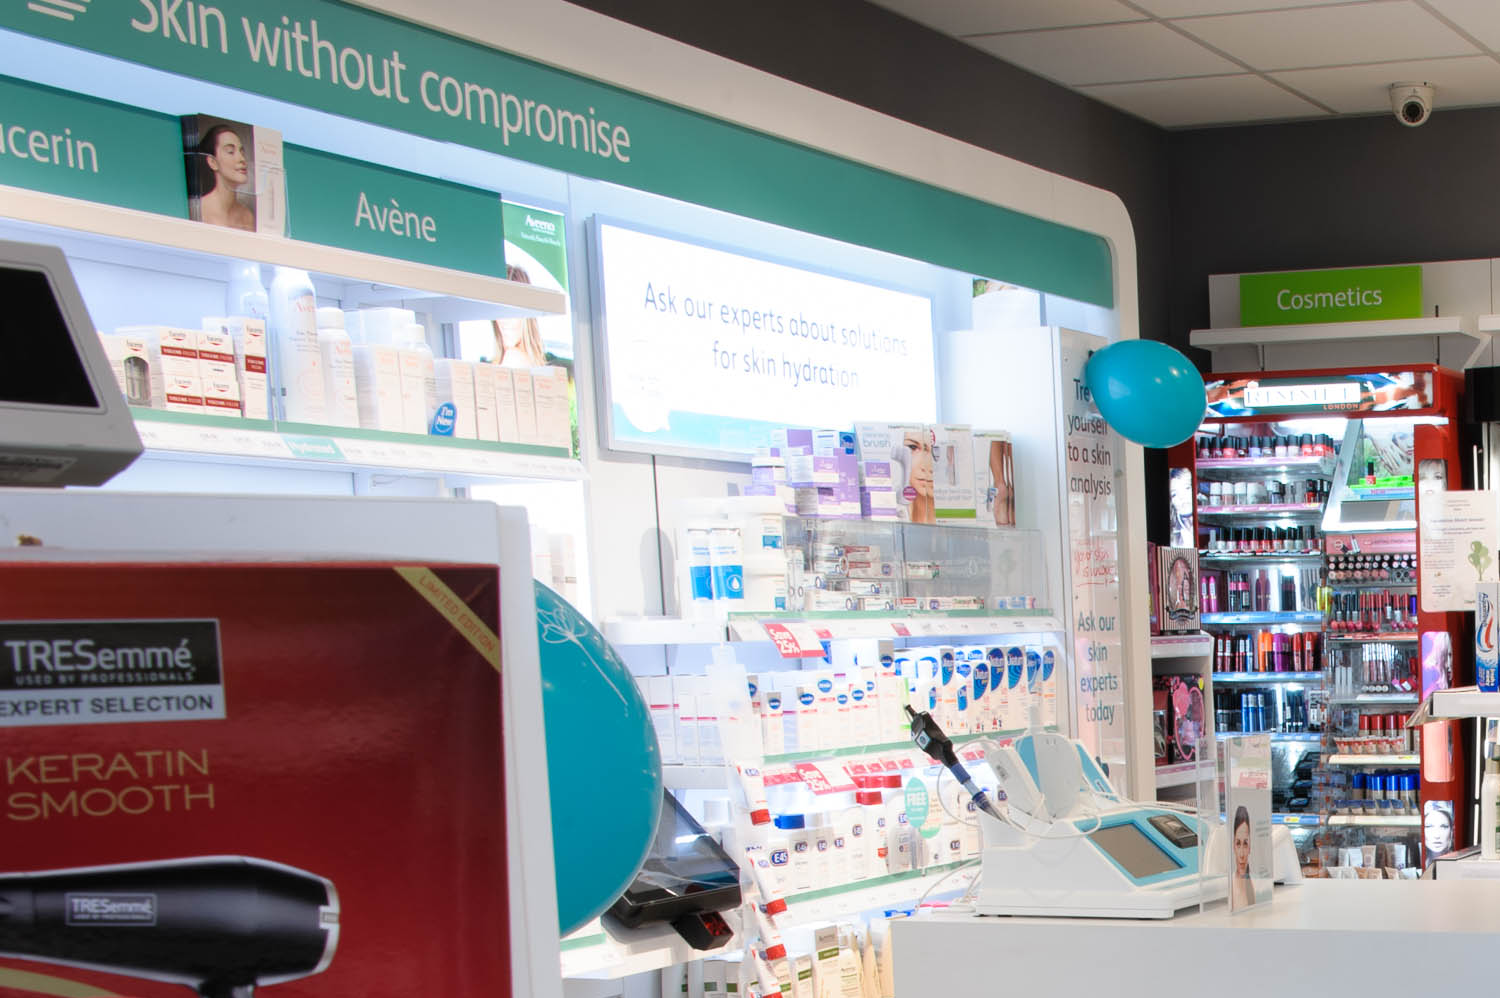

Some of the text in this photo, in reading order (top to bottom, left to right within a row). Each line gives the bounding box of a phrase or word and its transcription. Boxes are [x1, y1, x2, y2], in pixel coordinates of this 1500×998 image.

[131, 0, 631, 164] Skin without compromise
[0, 122, 99, 174] cerin
[354, 191, 437, 243] Avène
[1277, 286, 1383, 312] Cosmetics
[644, 282, 909, 357] Ask our experts about solutions
[712, 341, 859, 389] for skin hydration
[1073, 379, 1091, 402] Tre
[1322, 403, 1359, 411] LONDON
[1068, 442, 1111, 466] to a skin
[1070, 473, 1112, 500] analysis
[418, 574, 496, 652] LIMITED EDITION
[1078, 612, 1116, 632] Ask our
[4, 637, 193, 672] TRESemmé
[1088, 644, 1108, 662] skin
[16, 672, 194, 686] USED BY PROFESSIONALS
[1080, 674, 1118, 697] experts
[0, 695, 214, 718] EXPERT SELECTION
[1086, 699, 1115, 725] today
[6, 748, 209, 785] KERATIN
[7, 783, 216, 821] SMOOTH
[773, 852, 788, 864] E45
